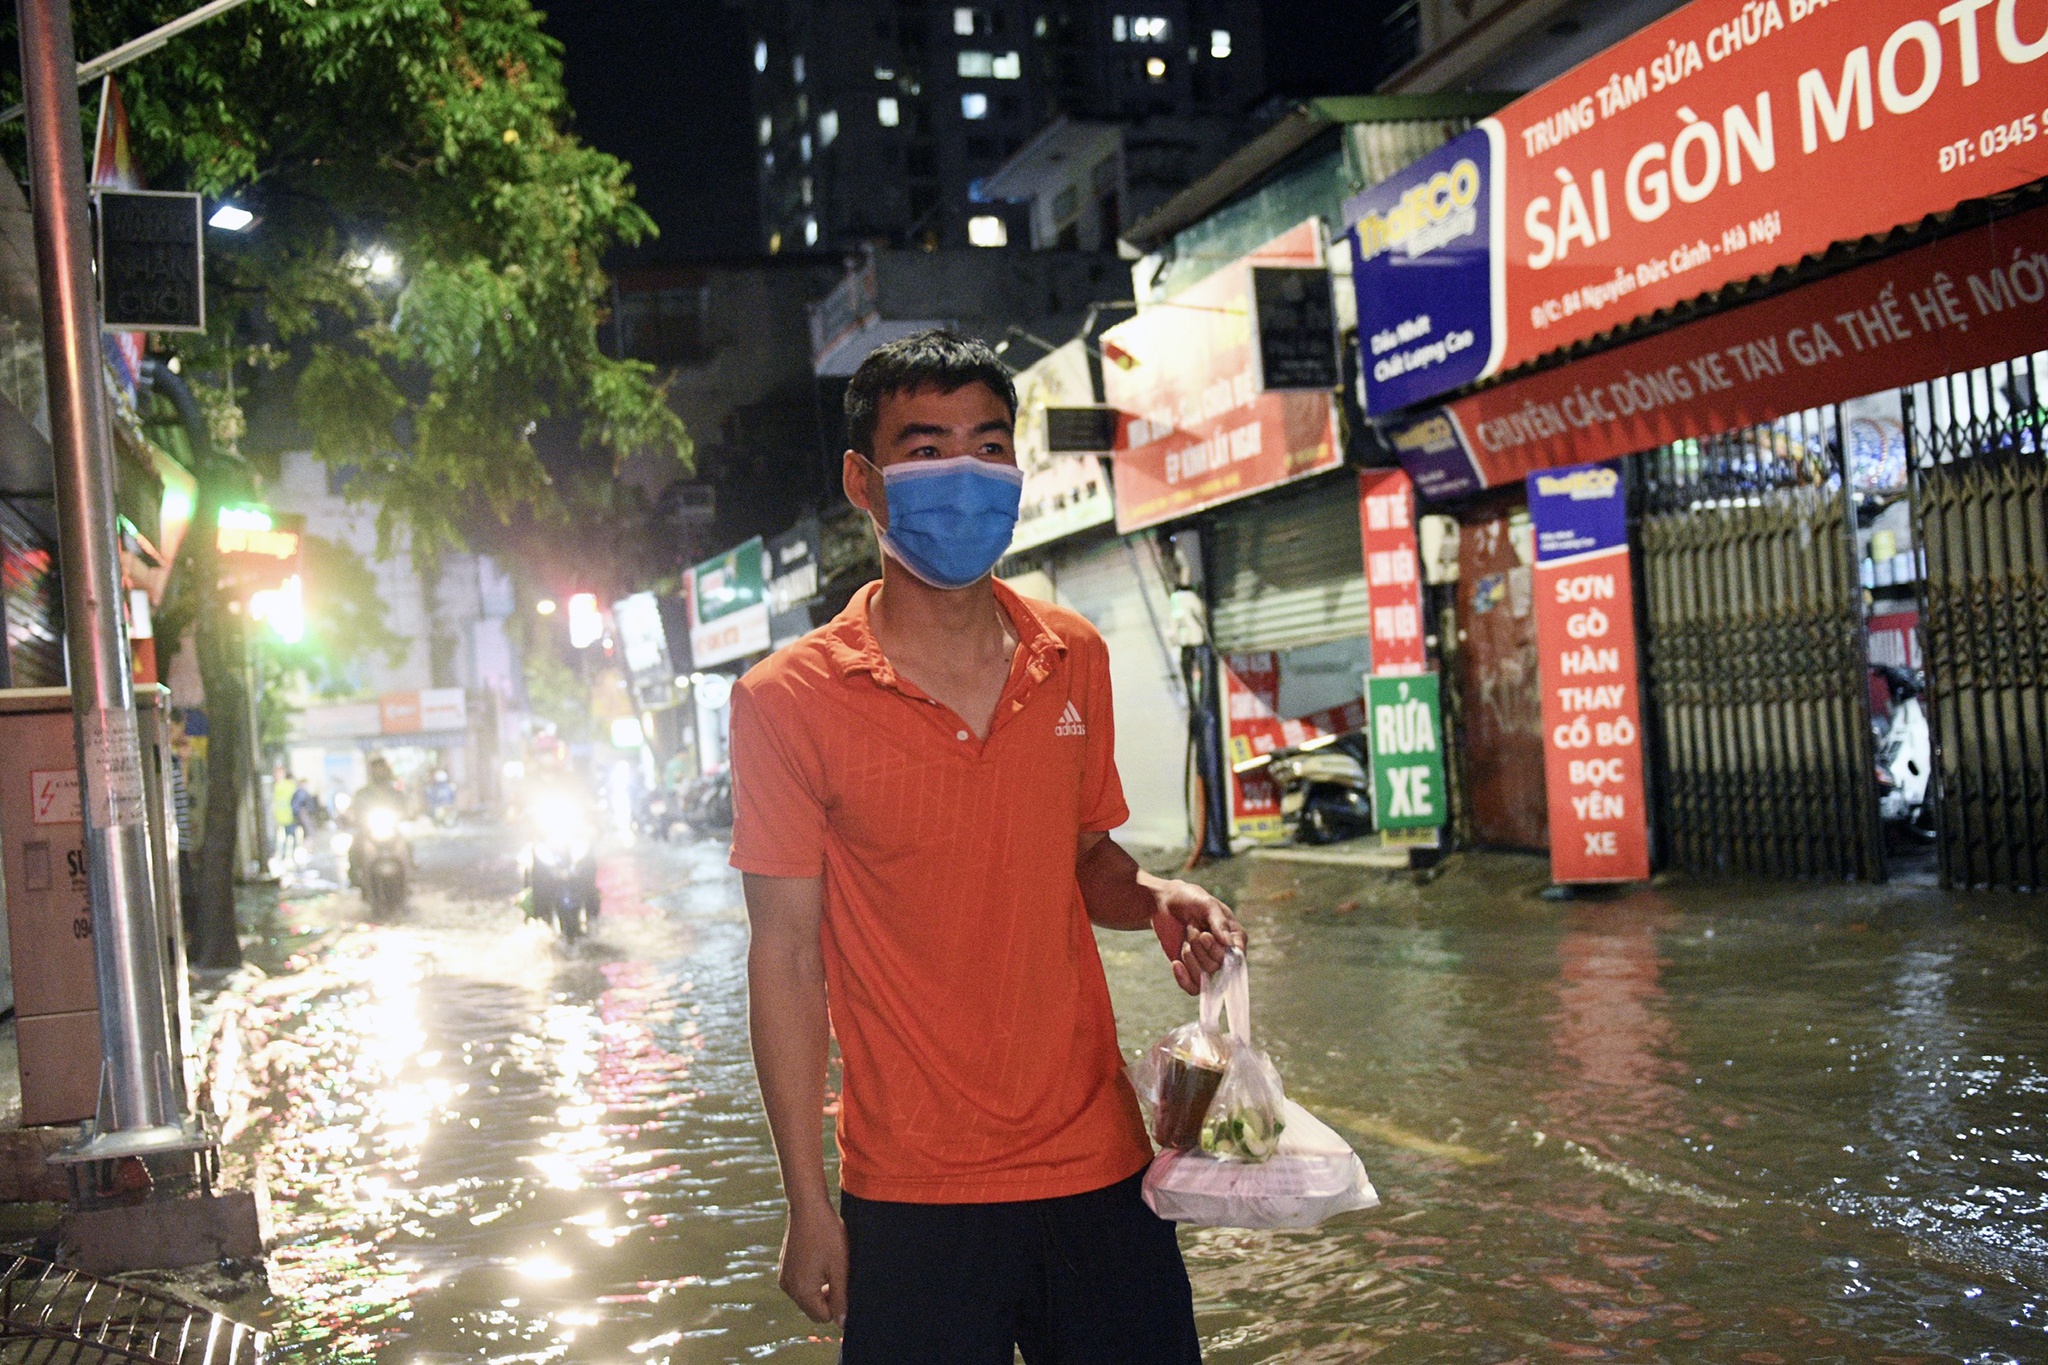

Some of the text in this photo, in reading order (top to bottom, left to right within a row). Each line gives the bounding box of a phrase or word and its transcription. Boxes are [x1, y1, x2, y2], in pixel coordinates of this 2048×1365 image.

[1522, 0, 1785, 158] TRUNG TÂM SỬA CHỮA
[1938, 138, 1976, 173] ĐT:
[1979, 113, 2038, 158] 0345
[1525, 166, 1611, 270] SÀI
[1624, 91, 1776, 223] GÒN
[1721, 224, 1748, 255] Hà
[1749, 209, 1782, 244] Nội
[1476, 400, 1567, 452] CHUYÊN
[1562, 384, 1617, 429] CÁC
[1610, 365, 1695, 416] DÒNG
[1687, 351, 1734, 392] XE
[1727, 335, 1785, 382] TAY
[1787, 321, 1845, 367] GA
[1834, 280, 1913, 351] THẾ
[1909, 271, 1969, 332] HỆ
[1966, 246, 2048, 316] MỚ
[1555, 574, 1615, 604] SƠN
[1566, 606, 1609, 639] GÒ
[1560, 644, 1619, 676] HÀN
[1556, 683, 1625, 713] THAY
[1054, 721, 1086, 737] adidas
[1375, 681, 1437, 756] RỬA
[1595, 714, 1636, 747] BÔ
[1568, 757, 1626, 788] BỌC
[1386, 765, 1434, 818] XE
[1571, 789, 1625, 820] YÊN
[1583, 831, 1618, 856] XE
